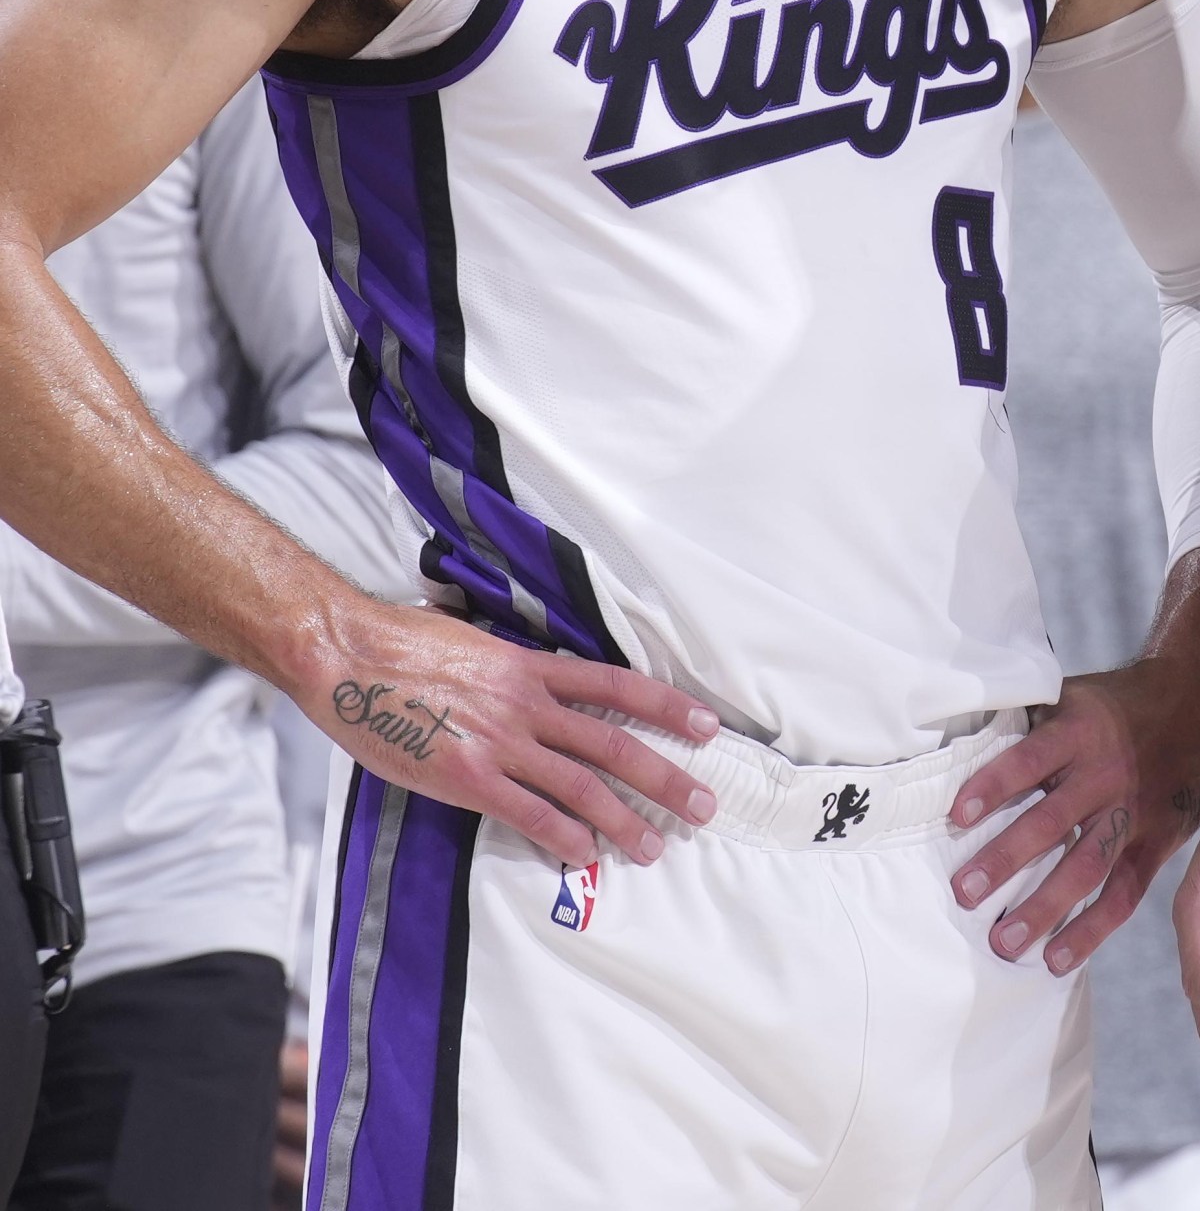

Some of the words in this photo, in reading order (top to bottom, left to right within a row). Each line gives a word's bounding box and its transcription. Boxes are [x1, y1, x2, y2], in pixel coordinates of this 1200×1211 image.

[931, 185, 1007, 391] 8
[332, 679, 465, 761] Saint
[555, 904, 577, 926] NBA
